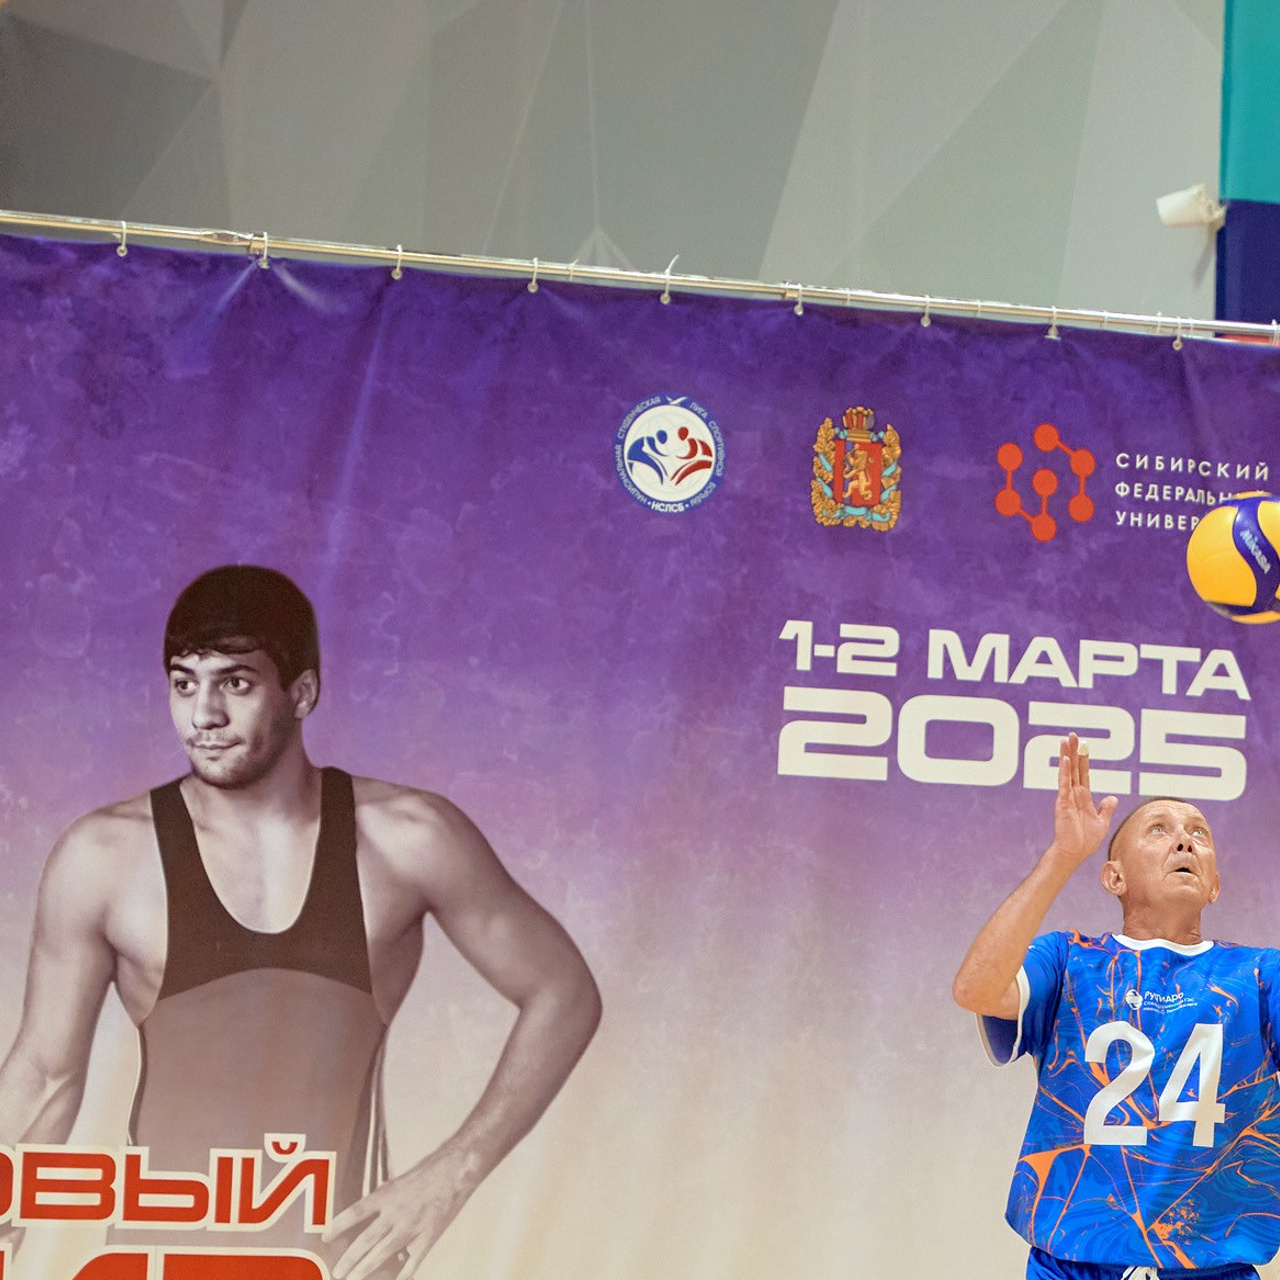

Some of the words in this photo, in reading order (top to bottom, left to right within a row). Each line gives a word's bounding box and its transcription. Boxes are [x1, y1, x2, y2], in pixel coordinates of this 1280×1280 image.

[650, 501, 685, 513] НСЛСБ
[1115, 452, 1269, 481] СИБИРСКИЙ
[1115, 510, 1200, 531] УНИВЕР
[778, 619, 900, 677] 1-2
[927, 628, 1252, 701] МАРТА
[777, 685, 1248, 802] 2025
[1084, 1020, 1226, 1148] 24
[0, 1140, 331, 1227] ВЫЙ
